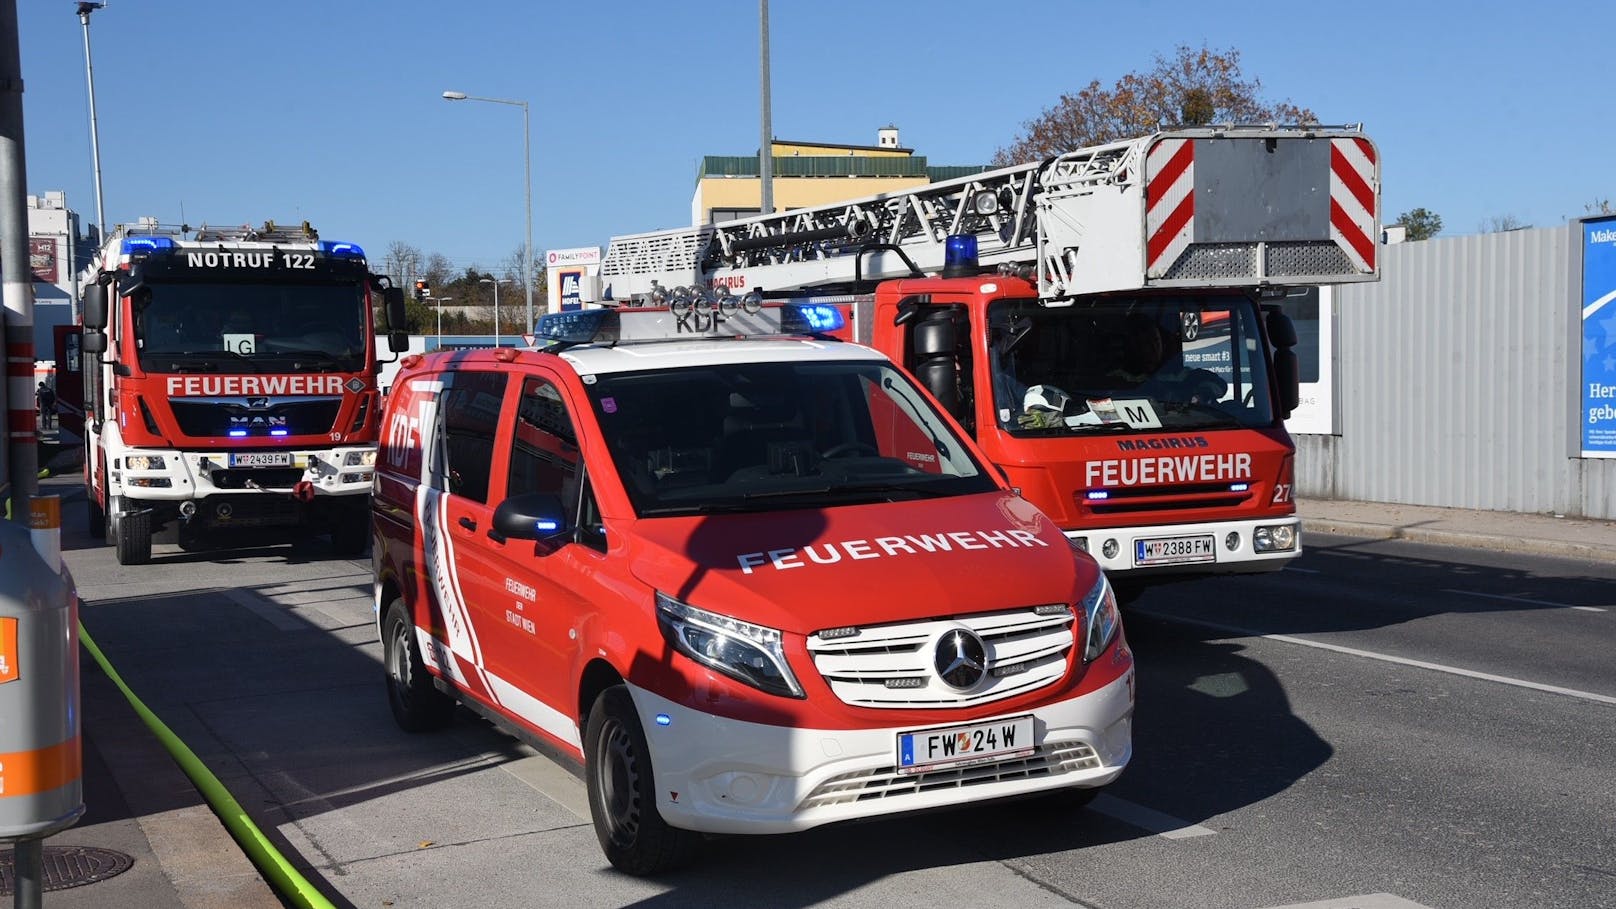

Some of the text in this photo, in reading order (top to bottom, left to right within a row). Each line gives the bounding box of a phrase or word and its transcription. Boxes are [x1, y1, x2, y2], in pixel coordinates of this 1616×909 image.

[188, 252, 316, 269] NOTRUF 122
[561, 297, 579, 305] HOFE
[676, 311, 726, 333] KDF
[1185, 351, 1230, 362] neue smart #3
[166, 376, 344, 396] FEUERWEHR
[230, 416, 286, 427] MAN
[1124, 406, 1150, 423] M
[387, 413, 420, 470] KDF
[1116, 436, 1209, 451] MAGIRUS
[236, 454, 288, 465] W 2439 FW
[1085, 453, 1252, 487] FEUERWEHR
[737, 529, 1048, 575] FEUERWEHR
[1145, 539, 1211, 556] W 2388 FW
[506, 577, 537, 603] FEUERWEHR
[505, 609, 536, 635] STADT WIEN
[928, 724, 1016, 758] FW 24 W
